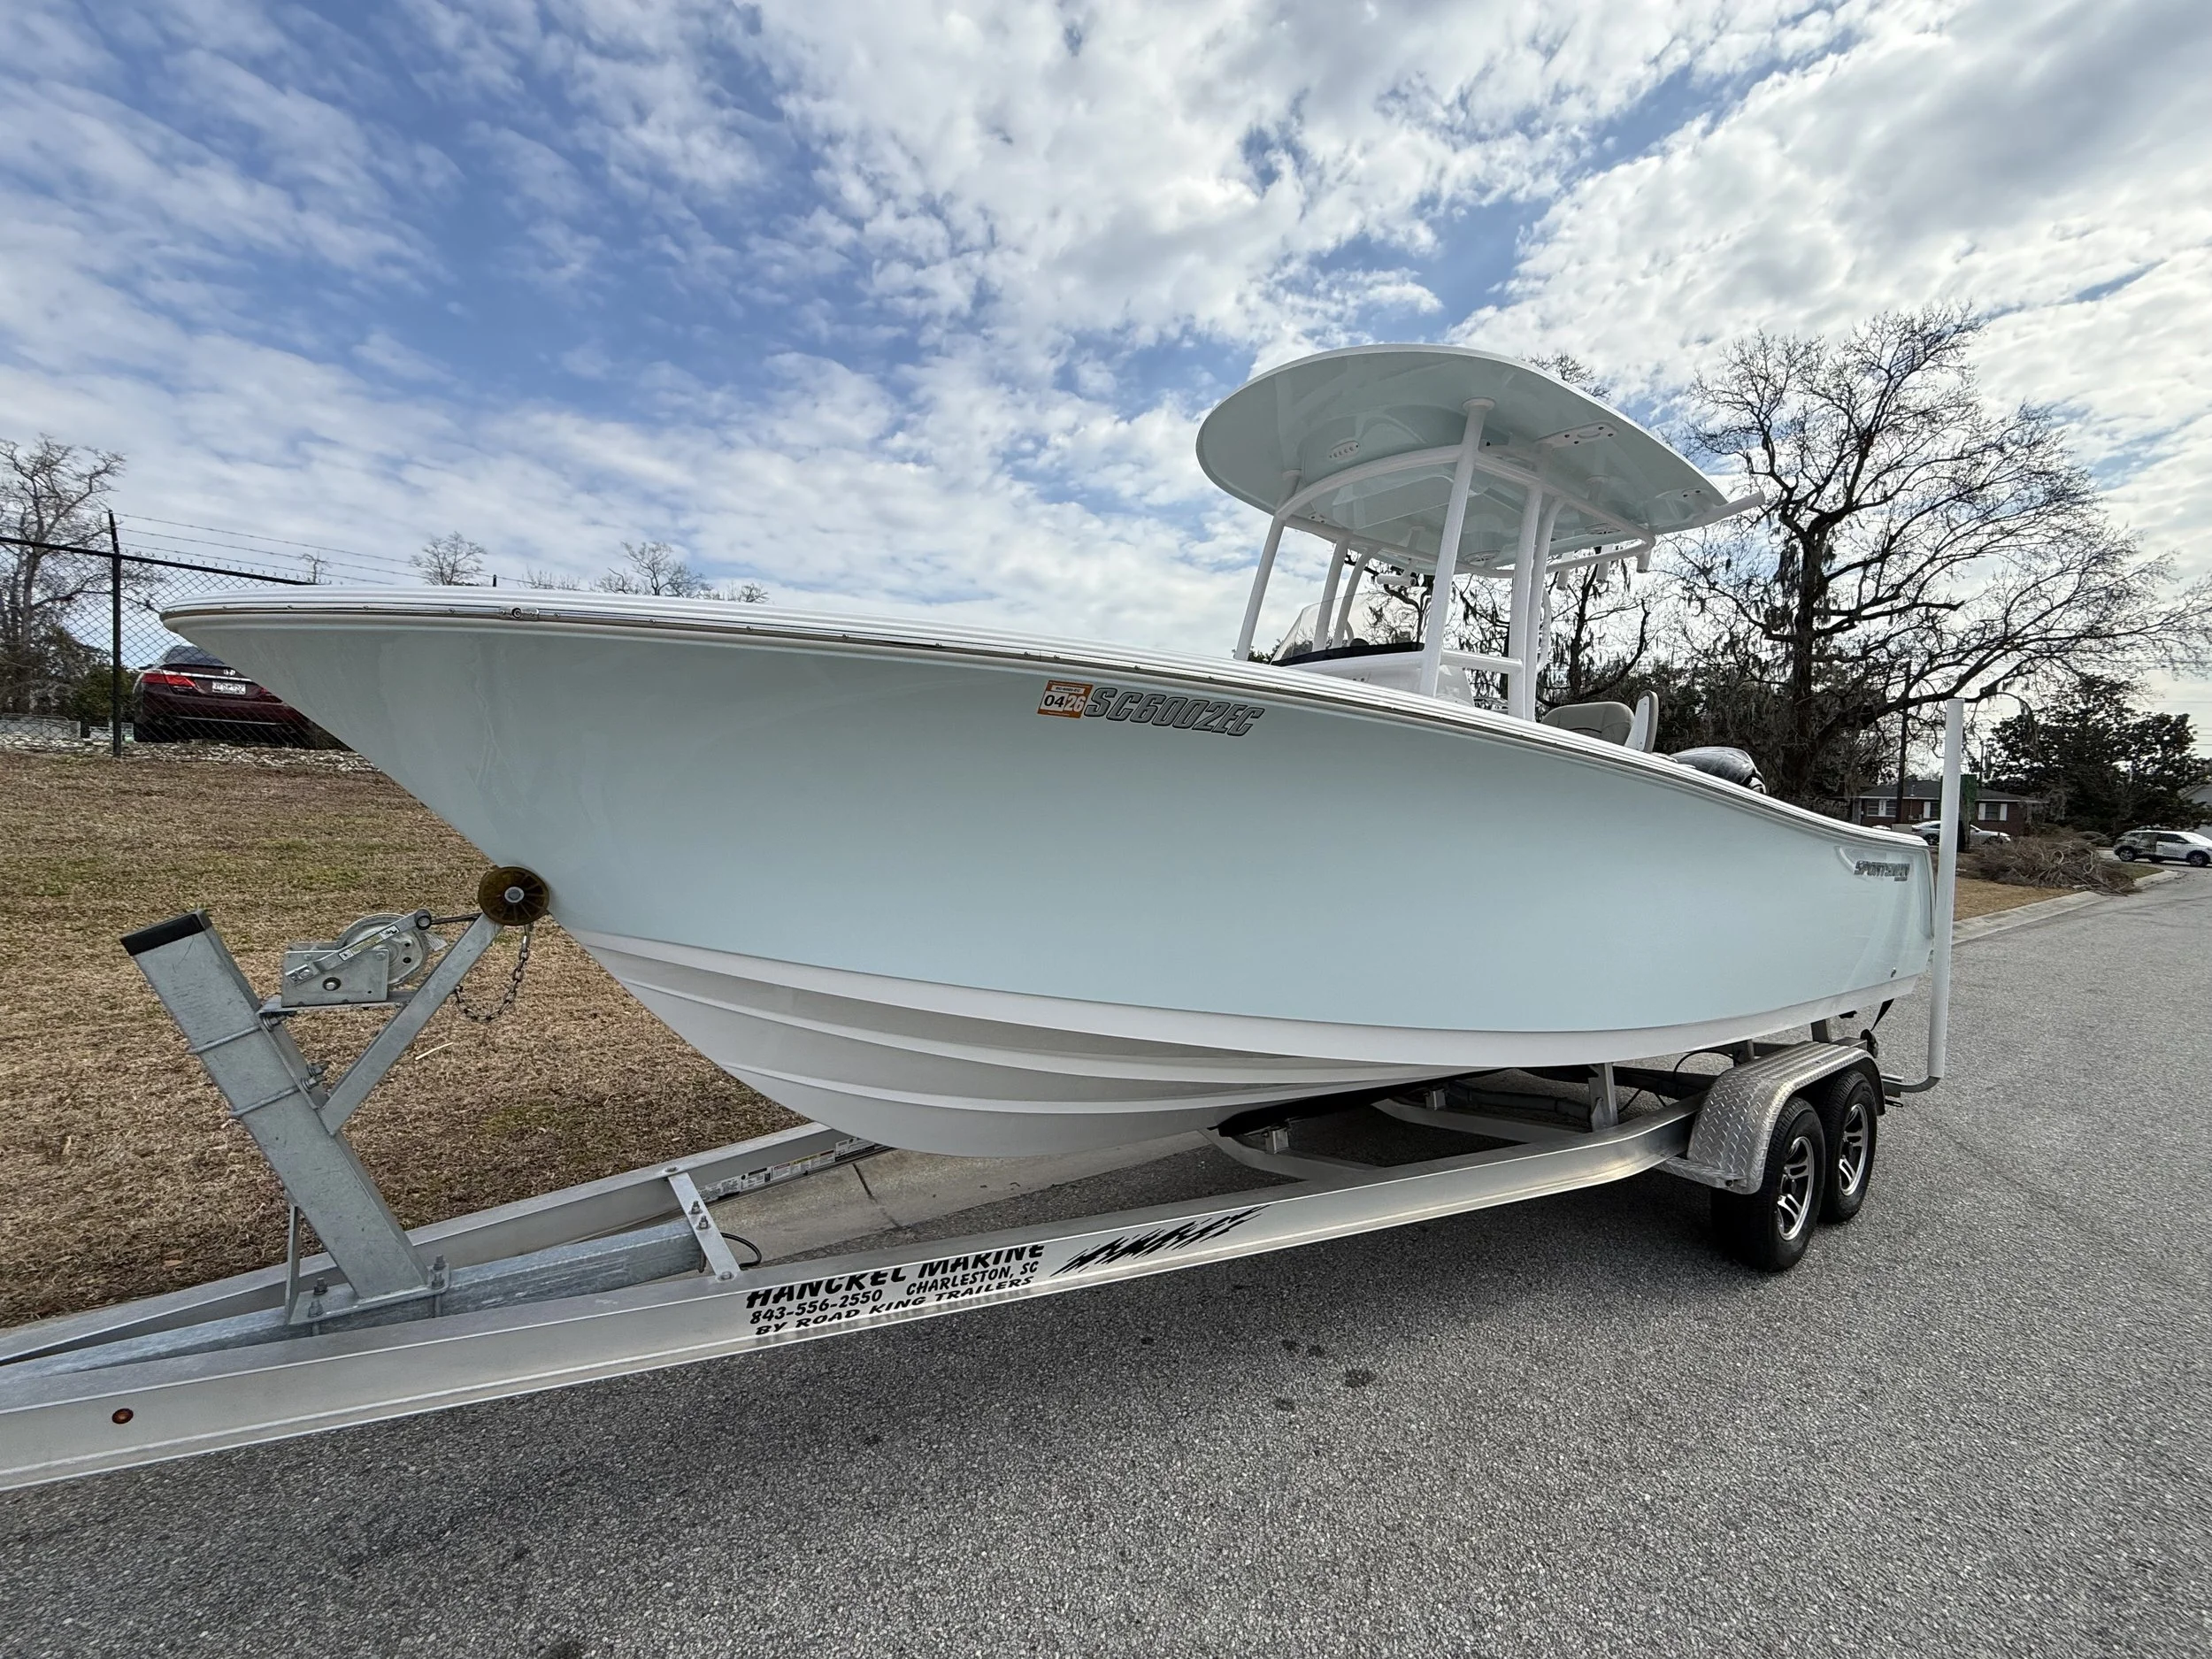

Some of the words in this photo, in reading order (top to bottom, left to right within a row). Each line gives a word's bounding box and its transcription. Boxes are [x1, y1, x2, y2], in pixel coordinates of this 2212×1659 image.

[1044, 695, 1065, 708] 04
[1064, 695, 1087, 712] 26
[1084, 687, 1265, 737] SC6002EC
[746, 1267, 907, 1309] HANCKEL
[918, 1244, 1045, 1279] MARINE
[750, 1289, 883, 1325] 843-556-2550
[906, 1266, 1014, 1296] CHARLESTON,
[1020, 1261, 1040, 1276] SC
[756, 1322, 787, 1336] BY
[795, 1310, 861, 1329] ROAD
[869, 1296, 926, 1315] KING
[935, 1276, 1034, 1302] TRAILERS
